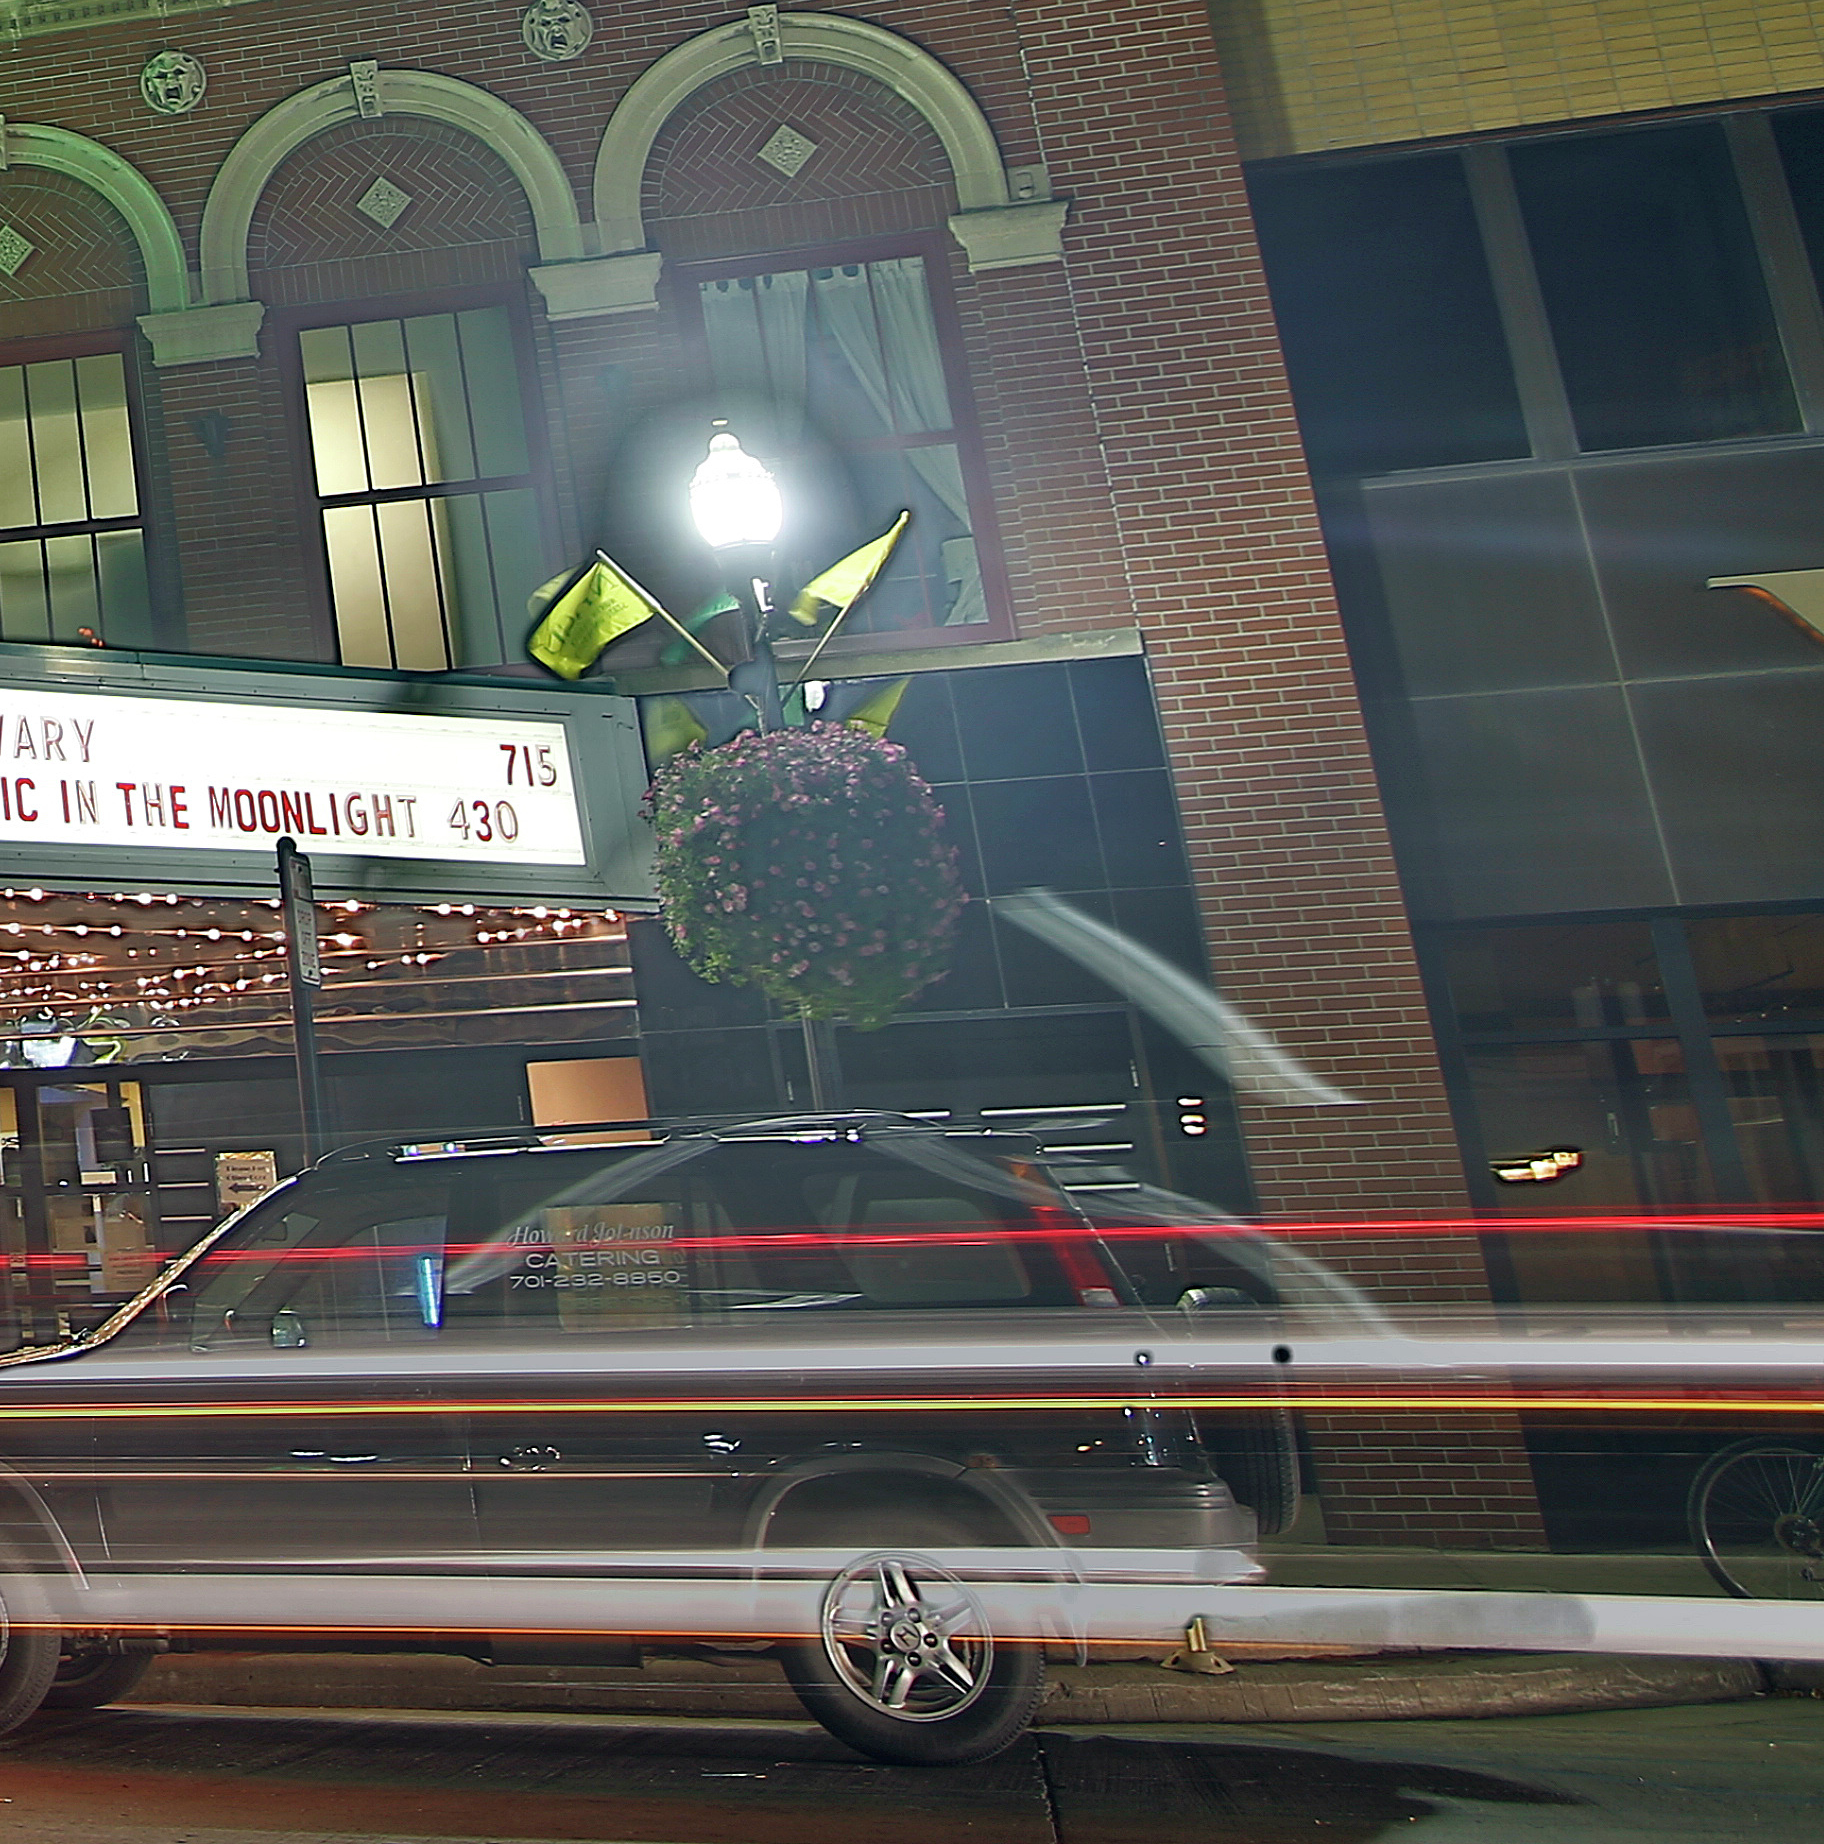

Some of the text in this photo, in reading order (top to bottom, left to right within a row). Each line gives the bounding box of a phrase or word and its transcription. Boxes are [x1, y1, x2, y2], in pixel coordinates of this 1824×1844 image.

[499, 743, 557, 788] 715
[61, 779, 98, 825] IN
[116, 782, 190, 829] THE
[210, 785, 417, 838] MOONLIGHT
[448, 799, 518, 842] 430
[507, 1223, 589, 1247] Howrd
[525, 1249, 661, 1269] CATERING
[509, 1270, 682, 1290] 701-232-8850
